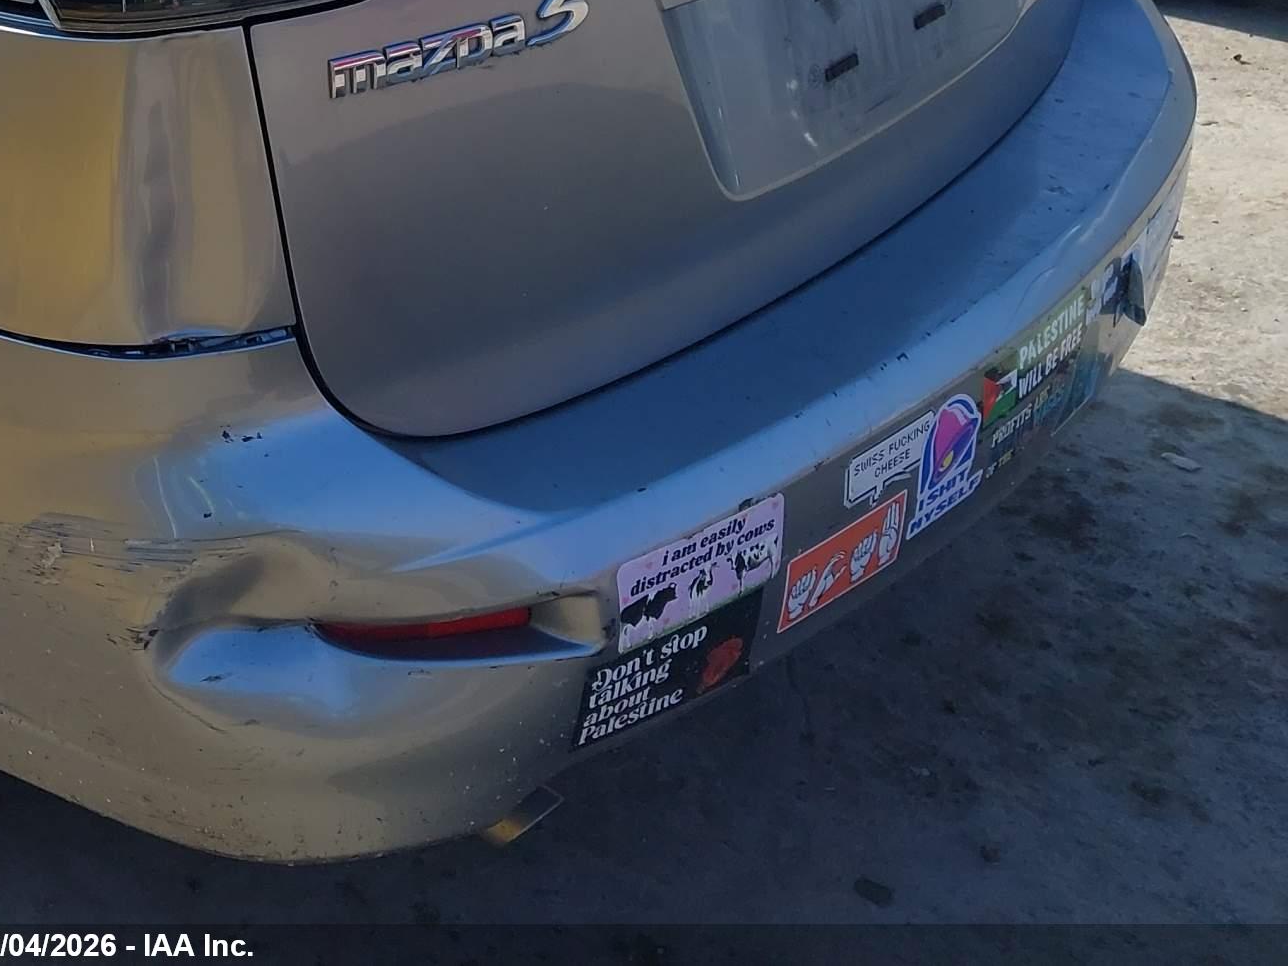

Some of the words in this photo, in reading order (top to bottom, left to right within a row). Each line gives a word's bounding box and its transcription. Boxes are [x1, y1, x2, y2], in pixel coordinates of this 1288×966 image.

[1019, 294, 1085, 370] PALESTINE
[1018, 362, 1043, 399] WILL
[1045, 347, 1059, 376] BE
[1060, 322, 1083, 362] FREE
[853, 449, 886, 477] SWISS
[888, 421, 930, 455] FUCKING
[874, 448, 911, 478] CHEESE
[910, 474, 981, 531] MYSELF
[919, 498, 925, 512] I
[926, 469, 968, 506] SHIT
[630, 545, 714, 597] distracted
[715, 539, 735, 558] by
[736, 518, 776, 546] cows
[662, 550, 670, 566] i
[670, 542, 697, 562] am
[700, 517, 747, 548] easily
[589, 658, 673, 709] talking
[591, 648, 655, 691] Don't
[660, 625, 708, 659] stop
[578, 688, 684, 746] Palestine
[583, 686, 652, 728] about
